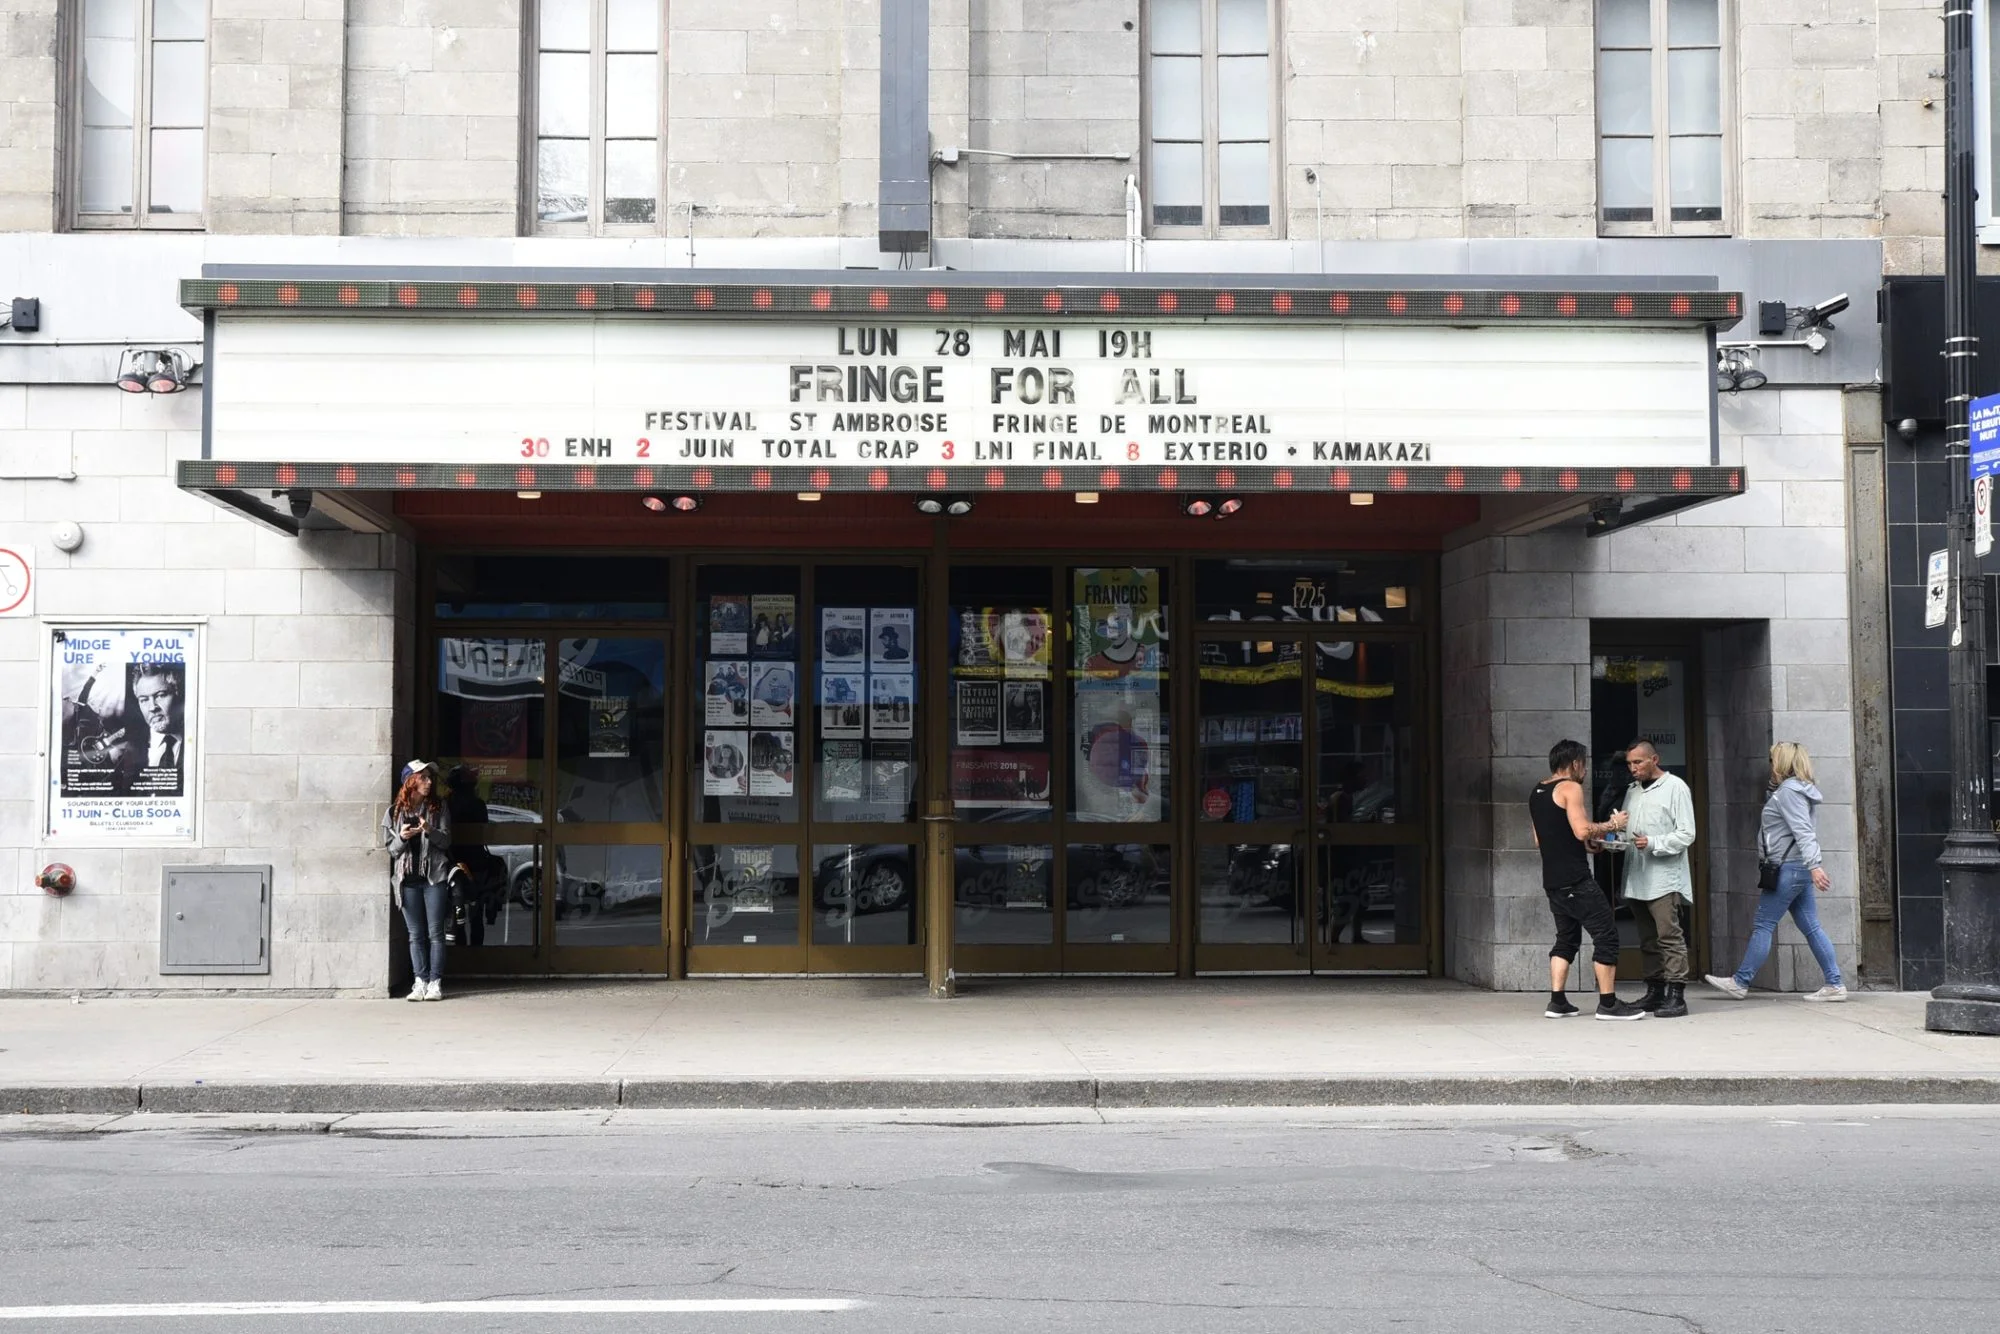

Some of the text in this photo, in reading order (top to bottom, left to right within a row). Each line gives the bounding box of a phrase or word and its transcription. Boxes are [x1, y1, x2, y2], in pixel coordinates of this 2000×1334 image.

[838, 326, 1152, 360] LUN 28 MAI 19H
[789, 365, 1198, 405] FRINGE FOR ALL
[645, 411, 1272, 435] FESTIVAL ST AMBROISE FRINGE DE MONTREAL
[520, 439, 550, 459] 30
[565, 439, 613, 459] ENH
[636, 439, 651, 459] 2
[679, 439, 735, 460] JUIN
[761, 439, 838, 460] TOTAL
[857, 440, 920, 460] CRAP
[941, 441, 956, 461] 3
[974, 441, 1014, 461] LNI
[1033, 442, 1103, 461] FINAL
[1126, 442, 1141, 462] 8
[1164, 442, 1269, 462] EXTERIO
[1313, 442, 1432, 462] KAMAKAZI
[1085, 584, 1148, 604] FRANCOS
[1293, 585, 1327, 609] 1225
[64, 637, 184, 650] MIDGE PAUL
[64, 651, 184, 666] URE YOUNG
[955, 761, 999, 770] FINISSANTS
[1000, 762, 1018, 770] 2018
[62, 808, 73, 819] 11
[76, 809, 102, 819] JUIN
[112, 807, 143, 819] CLUB
[146, 807, 182, 819] SODA
